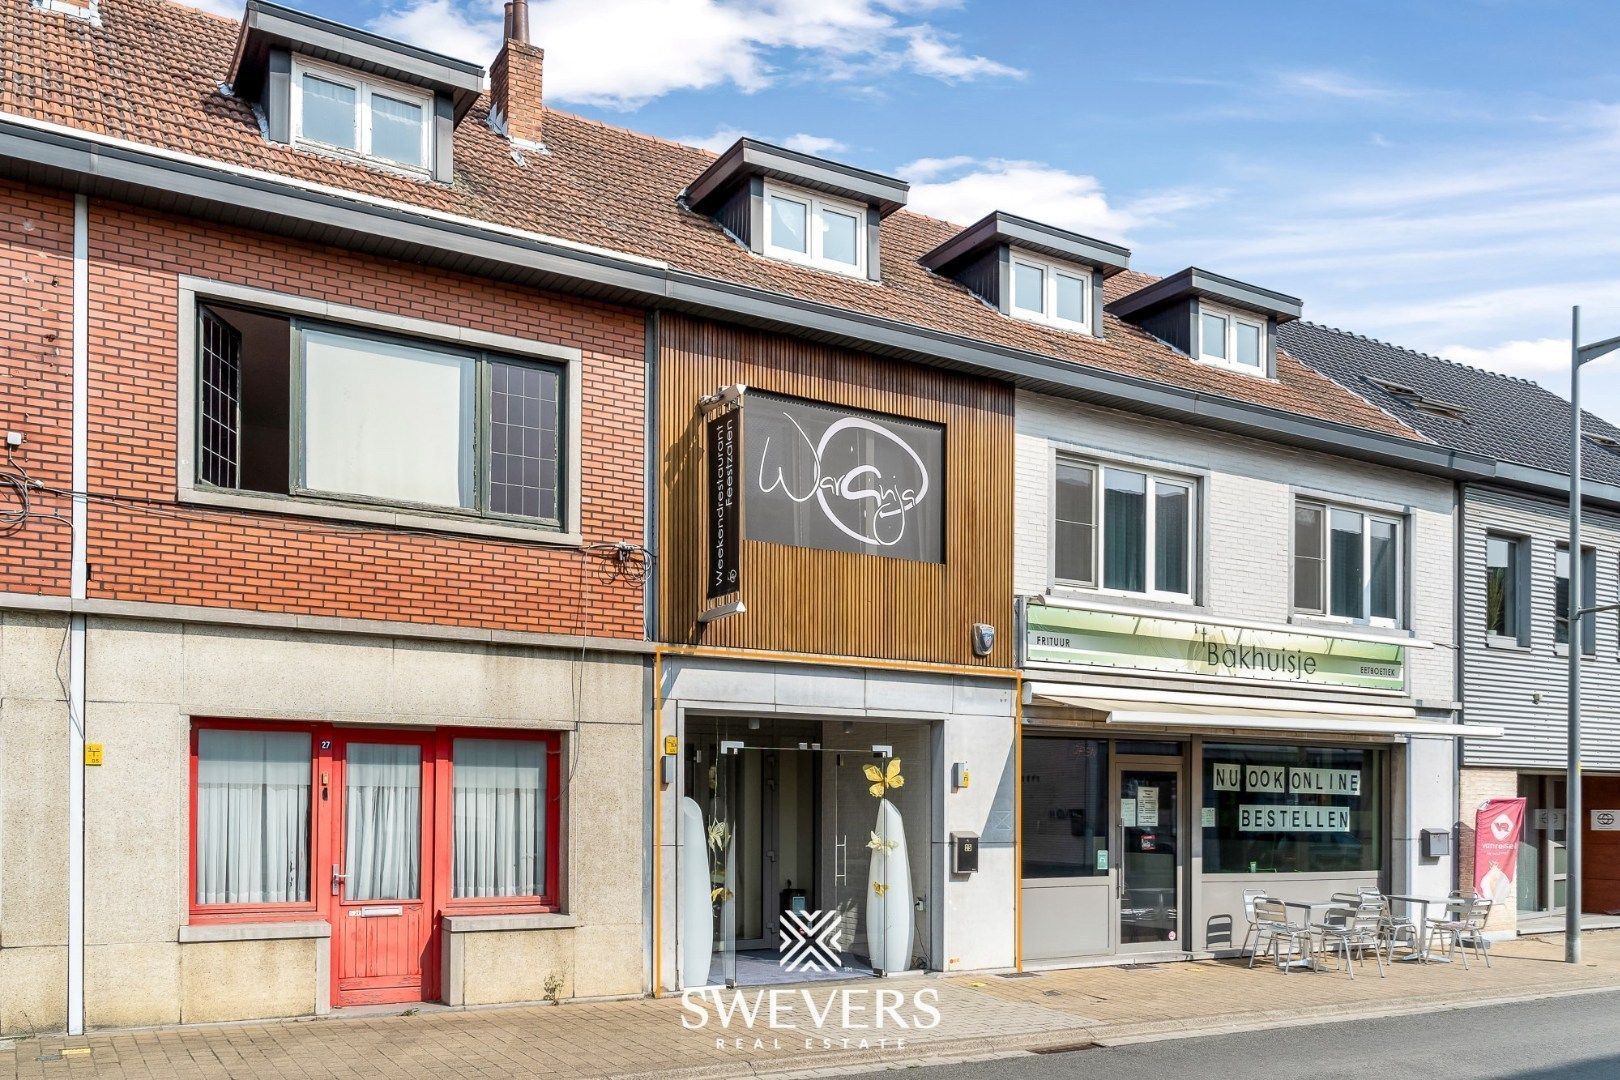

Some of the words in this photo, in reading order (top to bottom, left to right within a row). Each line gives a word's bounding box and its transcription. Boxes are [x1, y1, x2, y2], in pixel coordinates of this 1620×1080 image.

[725, 419, 733, 506] Feestzalen
[716, 424, 724, 586] Weekendrestaurant
[1036, 636, 1071, 647] FRITUUR
[1207, 642, 1317, 679] Bakhuisje
[321, 741, 331, 749] 27
[1215, 768, 1238, 787] NU
[1248, 770, 1284, 789] OOK
[1291, 772, 1359, 791] ONLINE
[1241, 809, 1348, 828] BESTELLEN
